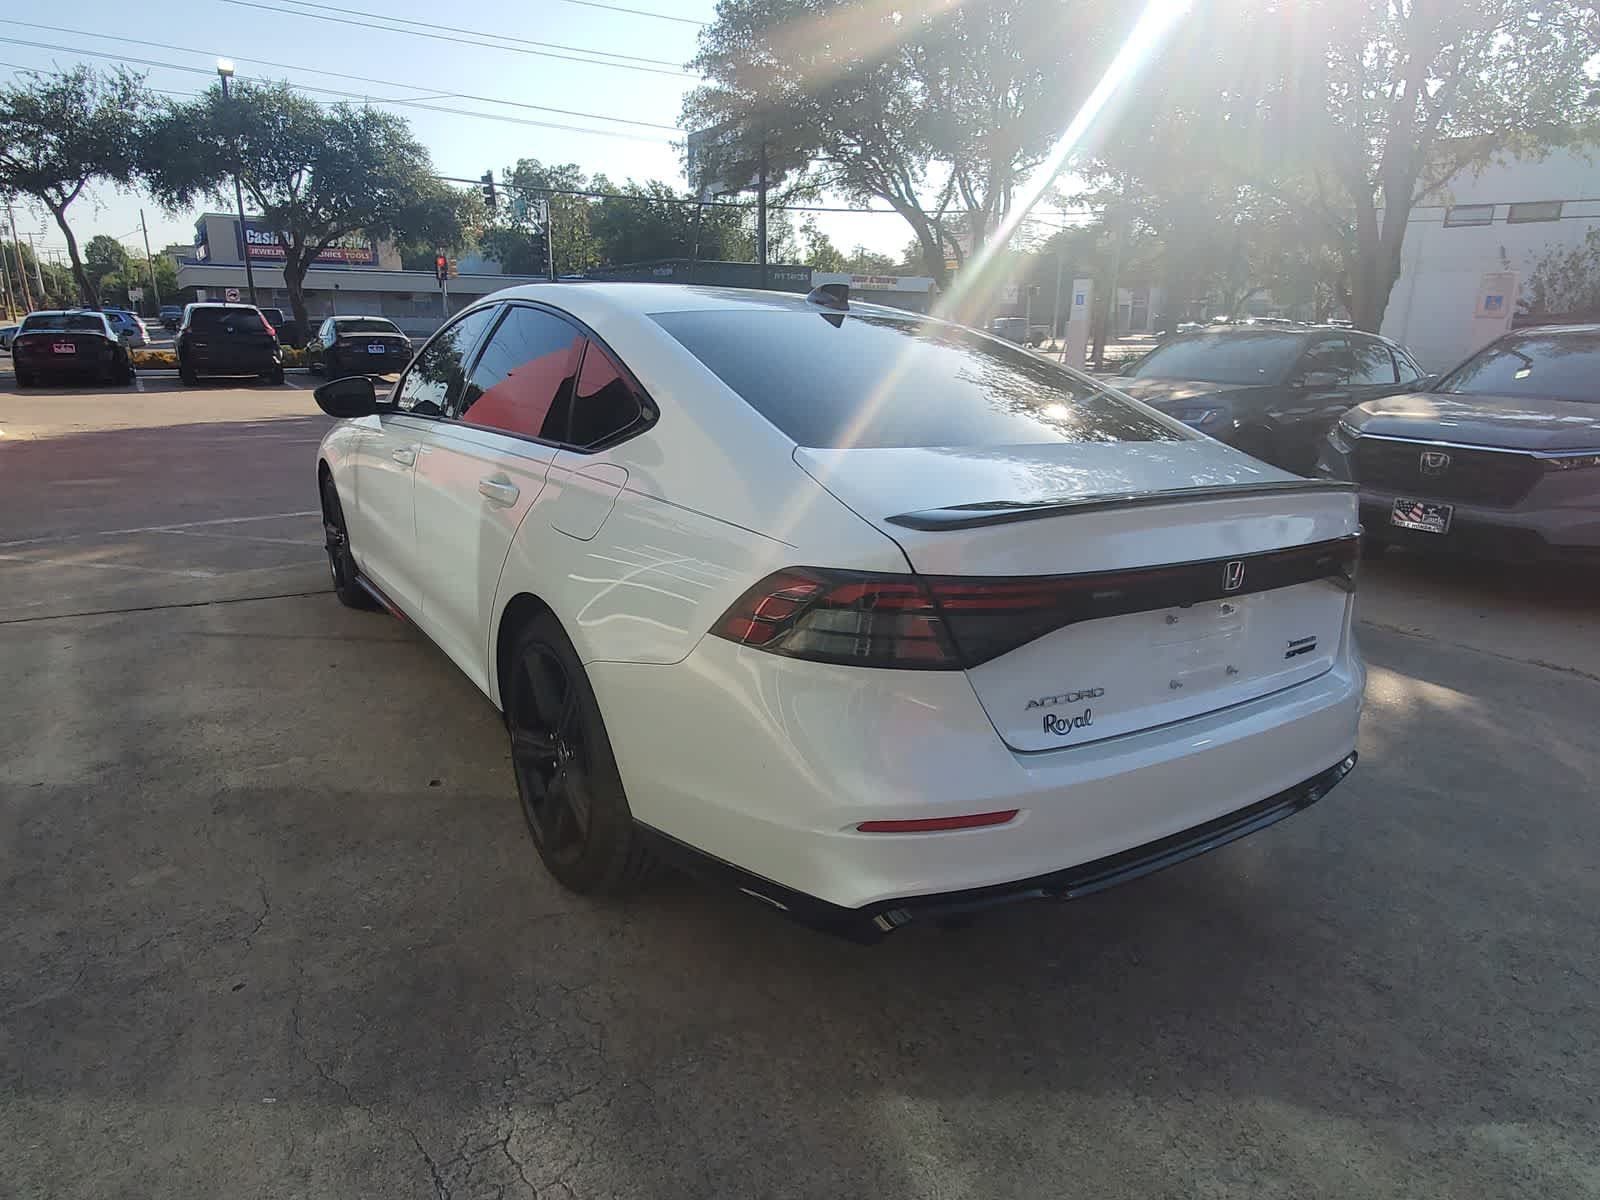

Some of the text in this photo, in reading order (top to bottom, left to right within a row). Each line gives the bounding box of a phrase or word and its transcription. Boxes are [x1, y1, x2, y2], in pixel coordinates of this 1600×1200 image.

[246, 229, 279, 245] Cash
[345, 252, 370, 260] TOOLS
[1024, 687, 1105, 711] ACCORD
[1043, 708, 1093, 736] Royal
